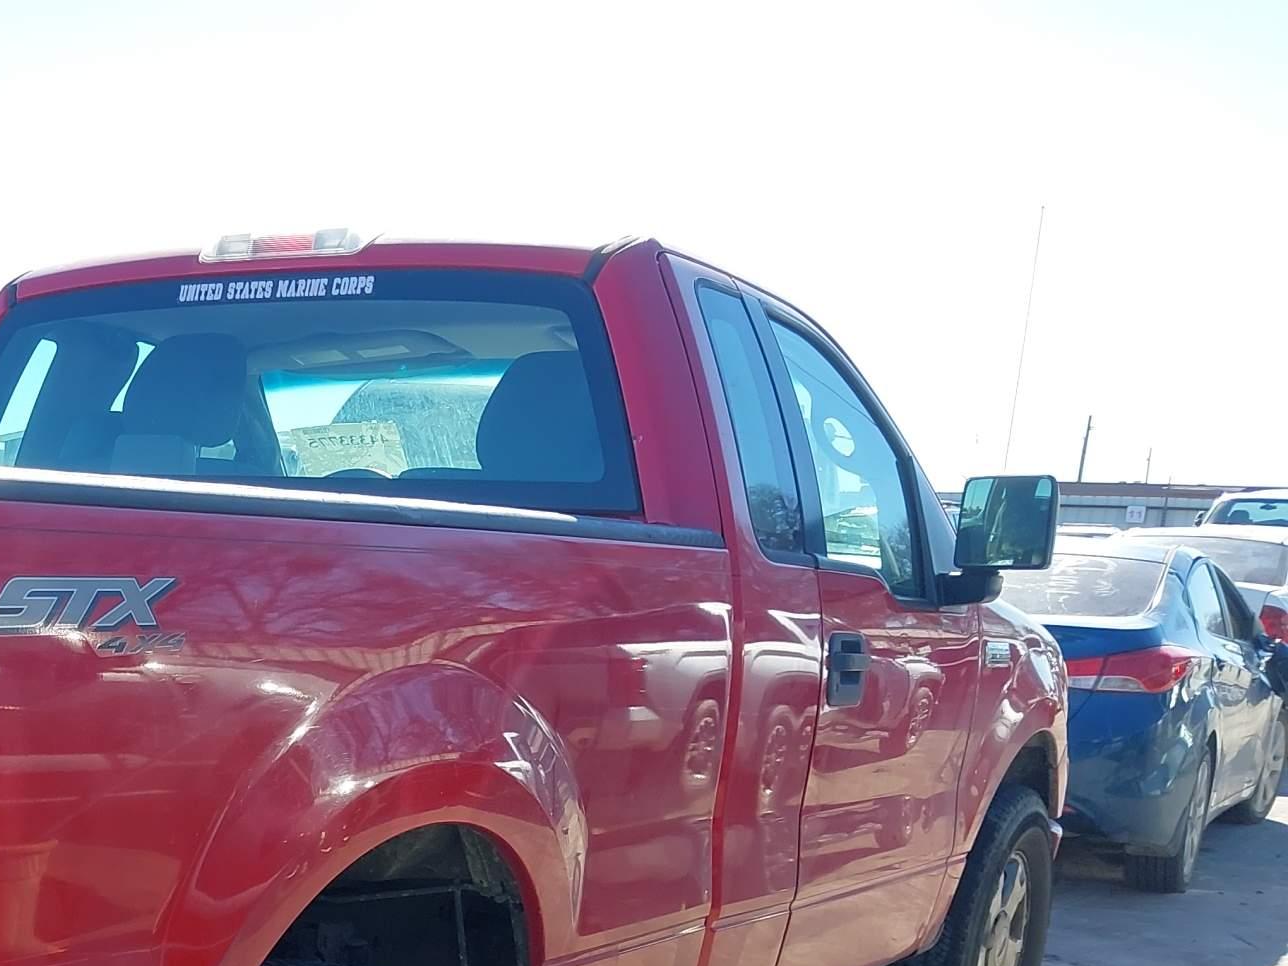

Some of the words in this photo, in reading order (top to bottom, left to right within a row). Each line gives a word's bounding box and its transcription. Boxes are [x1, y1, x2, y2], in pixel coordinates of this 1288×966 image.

[179, 283, 223, 302] UNITED
[227, 280, 273, 299] STATES
[276, 278, 328, 298] MARINE
[332, 276, 375, 295] CORPS
